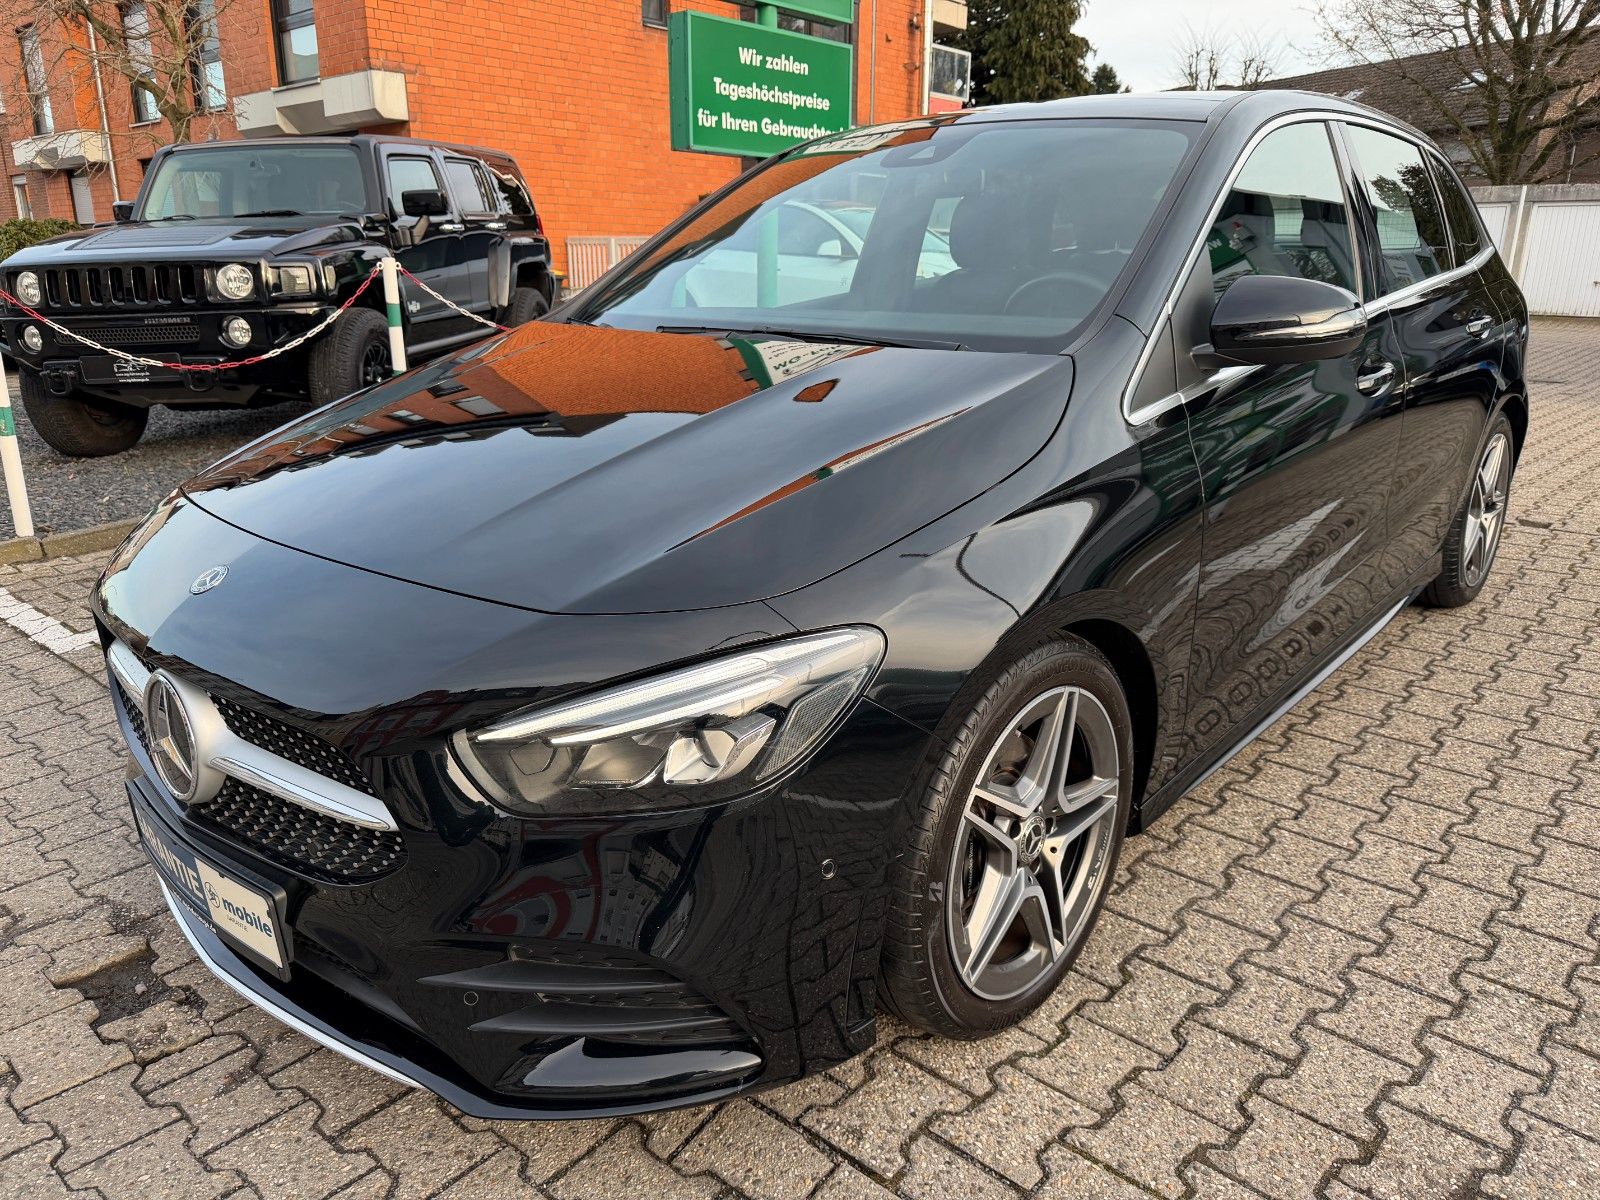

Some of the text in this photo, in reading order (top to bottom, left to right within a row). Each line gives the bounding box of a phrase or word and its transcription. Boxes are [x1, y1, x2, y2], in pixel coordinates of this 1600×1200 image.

[738, 46, 809, 76] Wir zahlen
[713, 76, 831, 111] Tageshöchstpreise
[697, 108, 718, 128] für
[721, 112, 758, 133] Ihren
[222, 897, 273, 938] mobile
